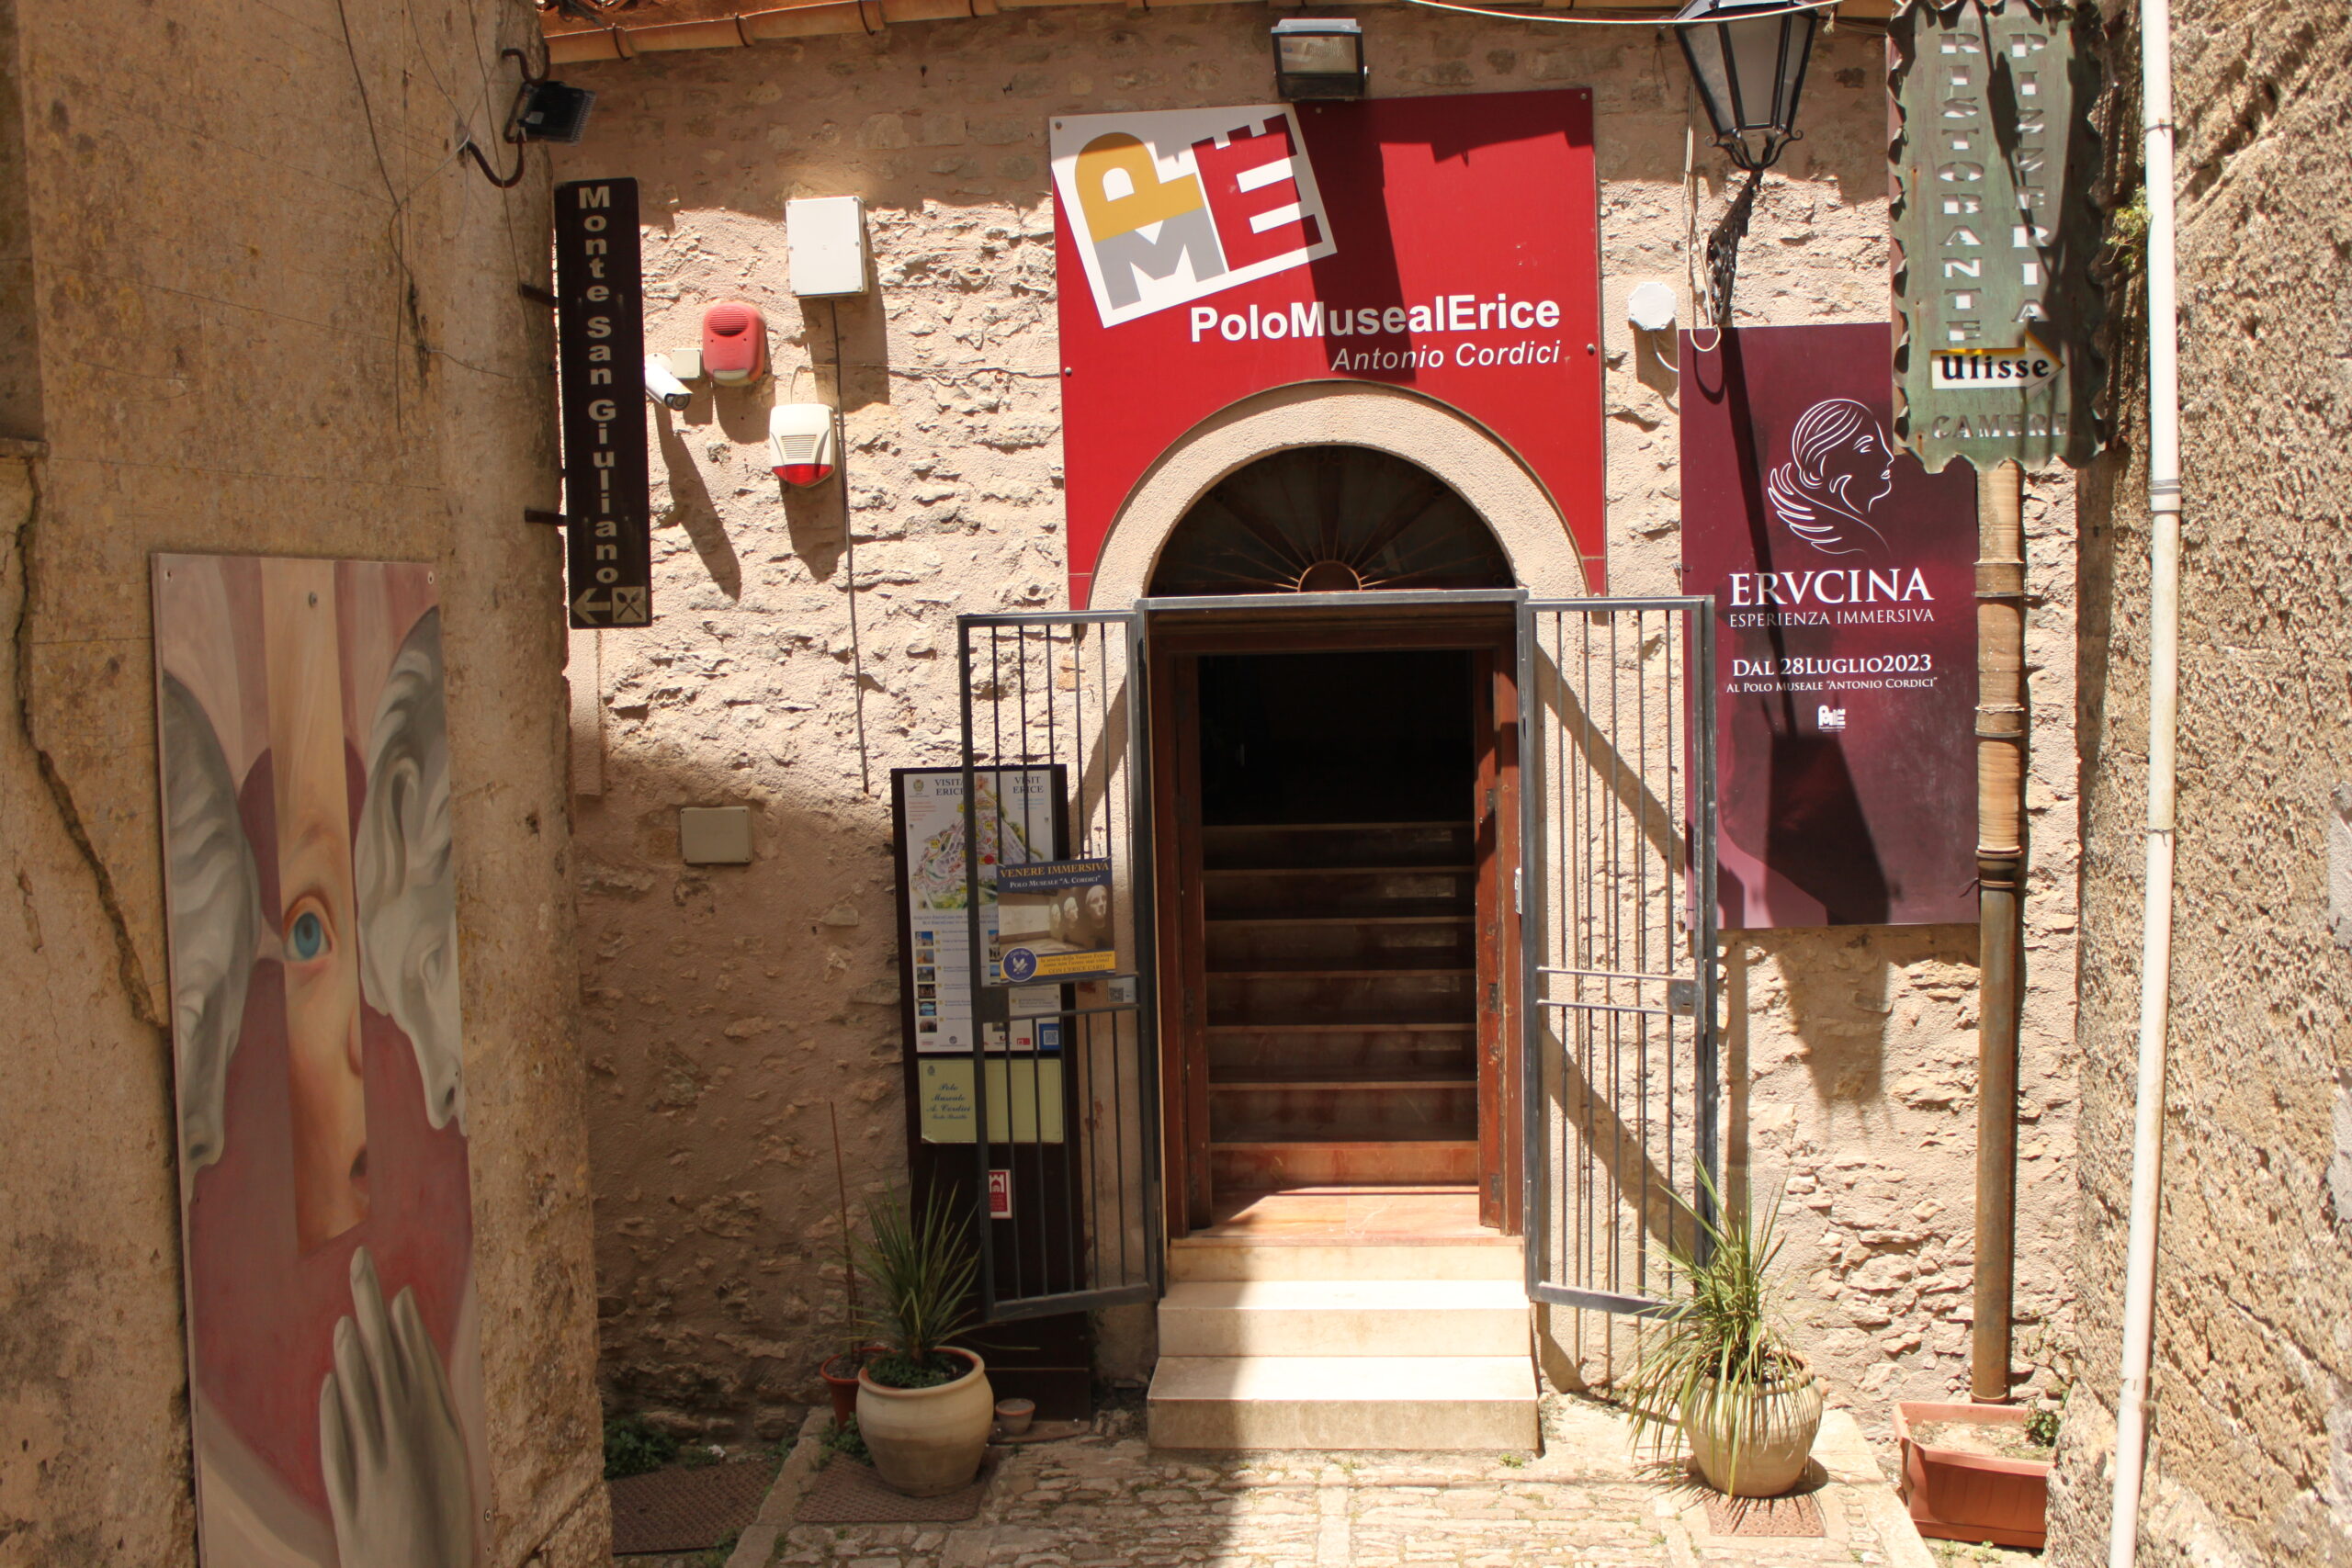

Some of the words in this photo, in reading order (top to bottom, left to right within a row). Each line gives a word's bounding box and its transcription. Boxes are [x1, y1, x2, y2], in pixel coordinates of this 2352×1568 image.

[1938, 33, 1984, 342] RISTORANTE
[2008, 32, 2049, 322] PIZZERIA
[579, 186, 610, 301] Monte
[1191, 292, 1560, 342] PoloMusealErice
[587, 315, 612, 385] San
[1331, 345, 1444, 372] Antonio
[1455, 339, 1560, 367] Cordici
[1932, 412, 2067, 438] CAMERE
[588, 399, 619, 583] Giuliano
[1728, 567, 1935, 606] ERVCINA
[1729, 612, 1830, 627] ESPERIENZA
[1838, 608, 1935, 625] IMMERSIVA
[1726, 683, 1740, 693] AL
[1000, 866, 1046, 878] VENERE
[1047, 862, 1109, 875] IMMERSIVA
